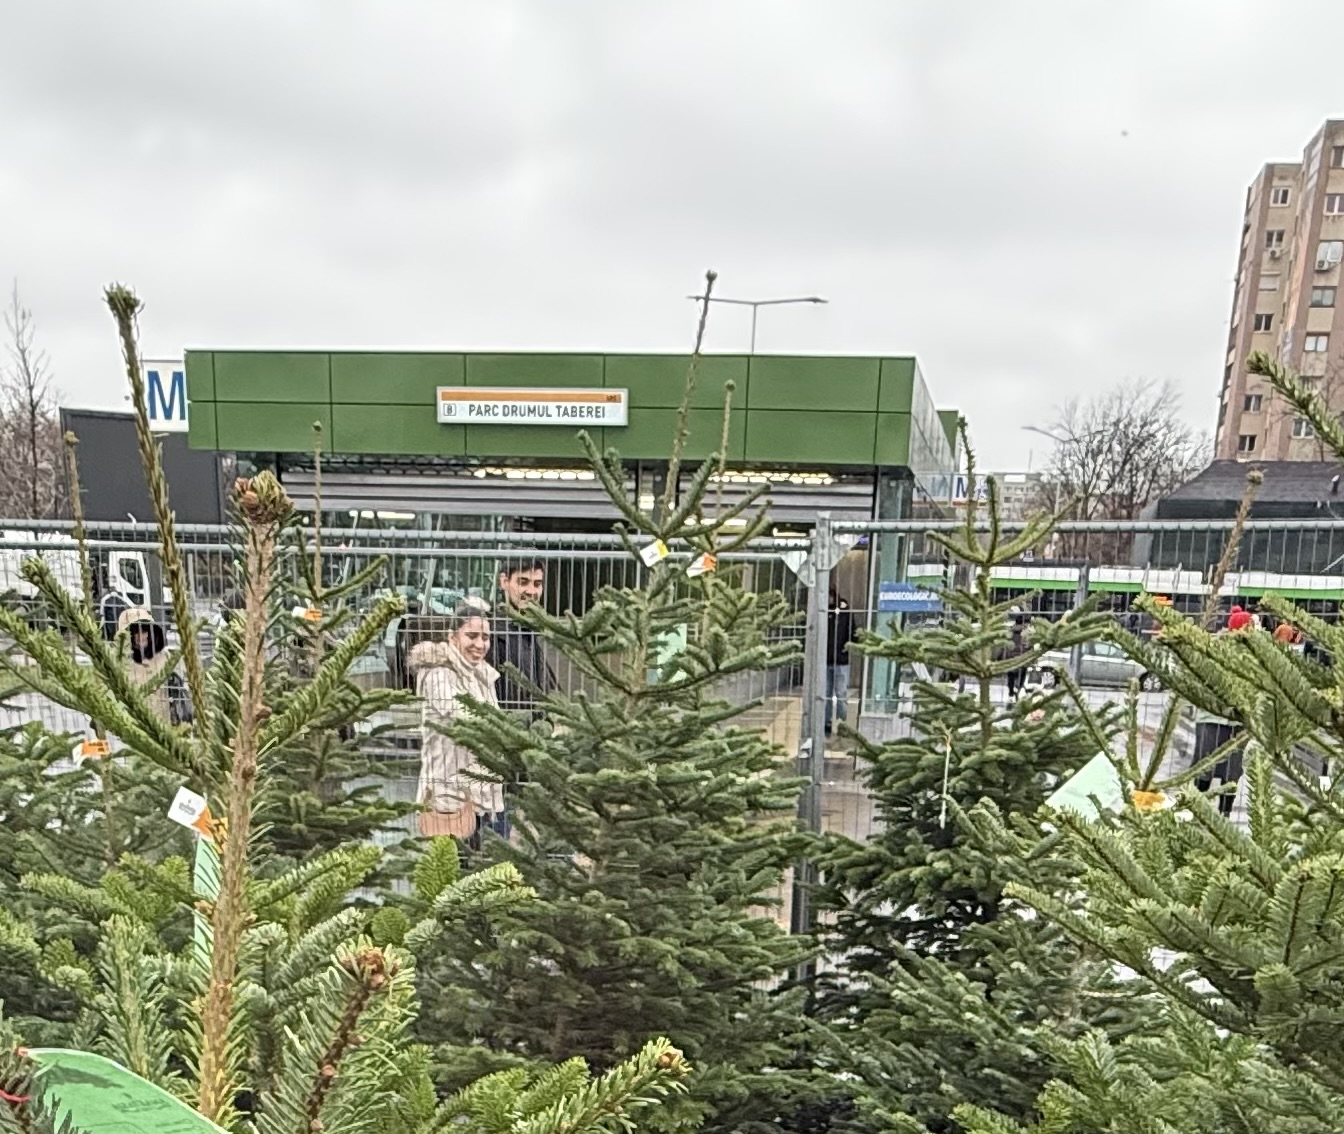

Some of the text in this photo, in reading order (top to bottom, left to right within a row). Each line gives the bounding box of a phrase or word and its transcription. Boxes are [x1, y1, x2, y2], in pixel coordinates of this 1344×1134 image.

[147, 370, 186, 421] M
[468, 404, 499, 417] PARC
[502, 405, 552, 418] DRUMUL
[556, 405, 606, 419] TABEREI
